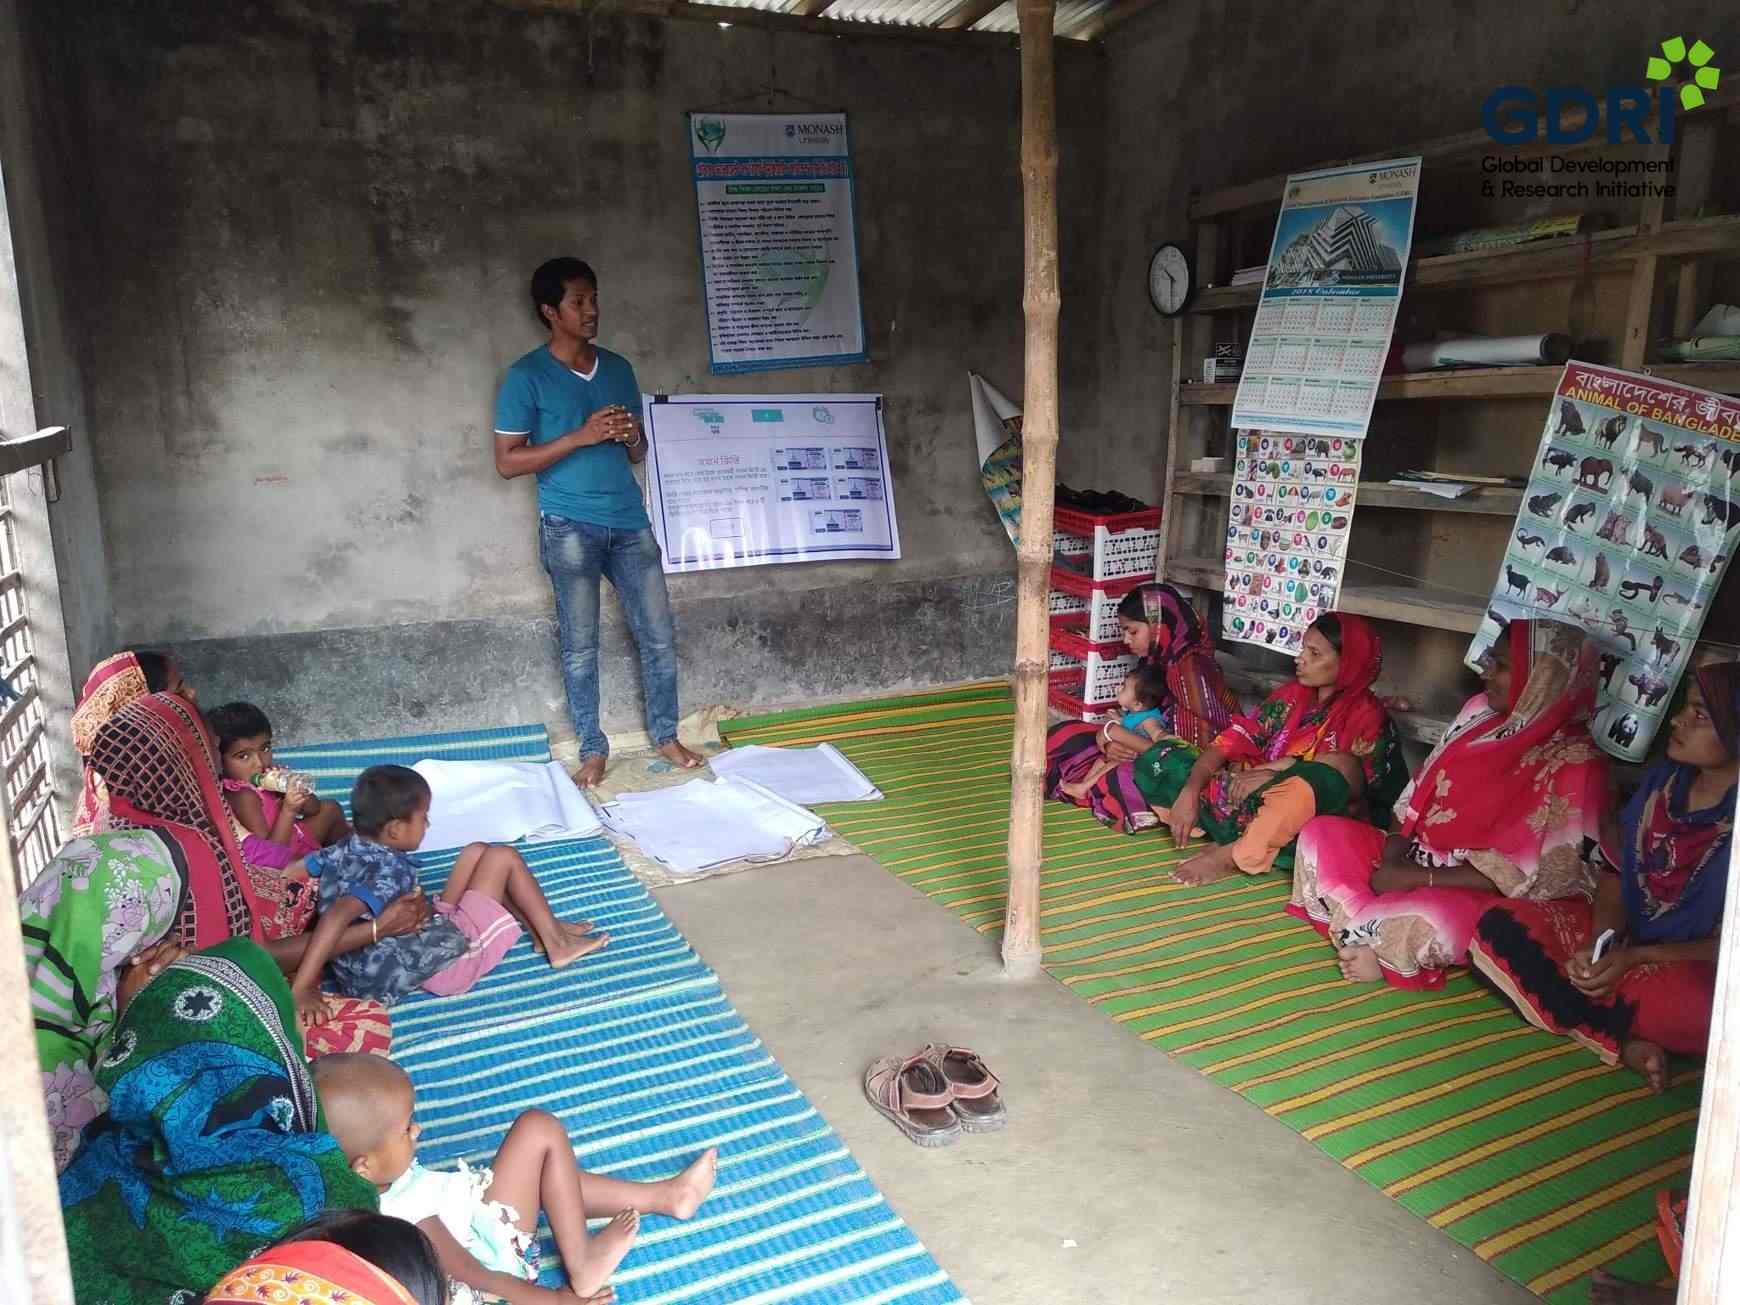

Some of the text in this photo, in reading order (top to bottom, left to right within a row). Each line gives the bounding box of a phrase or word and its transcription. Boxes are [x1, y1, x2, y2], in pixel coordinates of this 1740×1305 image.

[798, 124, 843, 136] MONASH
[1565, 386, 1622, 411] ANIMAL
[1626, 401, 1649, 417] OF
